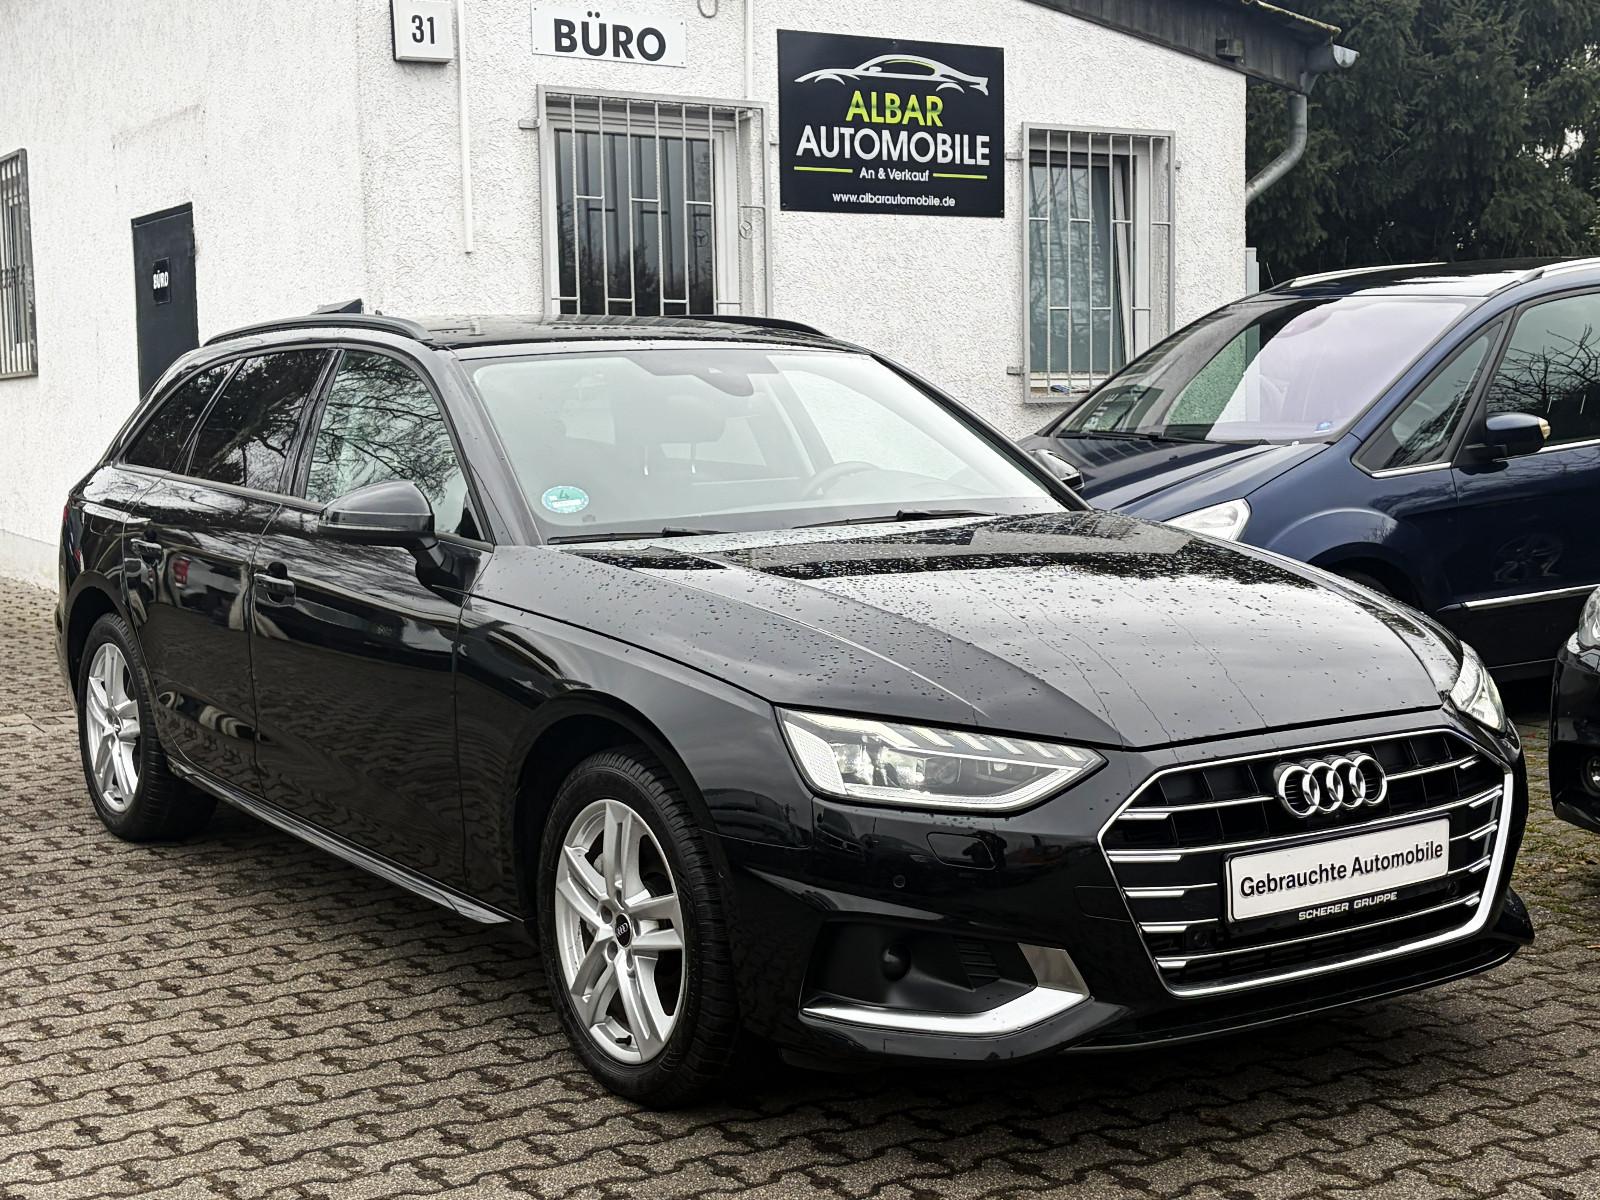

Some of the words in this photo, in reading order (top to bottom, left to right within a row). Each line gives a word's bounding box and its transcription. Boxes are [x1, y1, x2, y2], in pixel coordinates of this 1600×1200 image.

[411, 14, 435, 45] 31
[553, 10, 667, 62] BÜRO
[845, 90, 944, 127] ALBAR
[795, 124, 990, 166] AUTOMOBILE
[859, 167, 875, 180] An
[877, 168, 886, 180] &
[887, 169, 930, 182] Verkauf
[832, 192, 956, 207] www.albarautomobile.de
[152, 269, 169, 290] BÜRO
[1240, 863, 1347, 897] Gebrauchte
[1351, 840, 1443, 877] Automobile
[1298, 902, 1349, 921] SCHERER
[1353, 891, 1398, 909] GRUPPE
